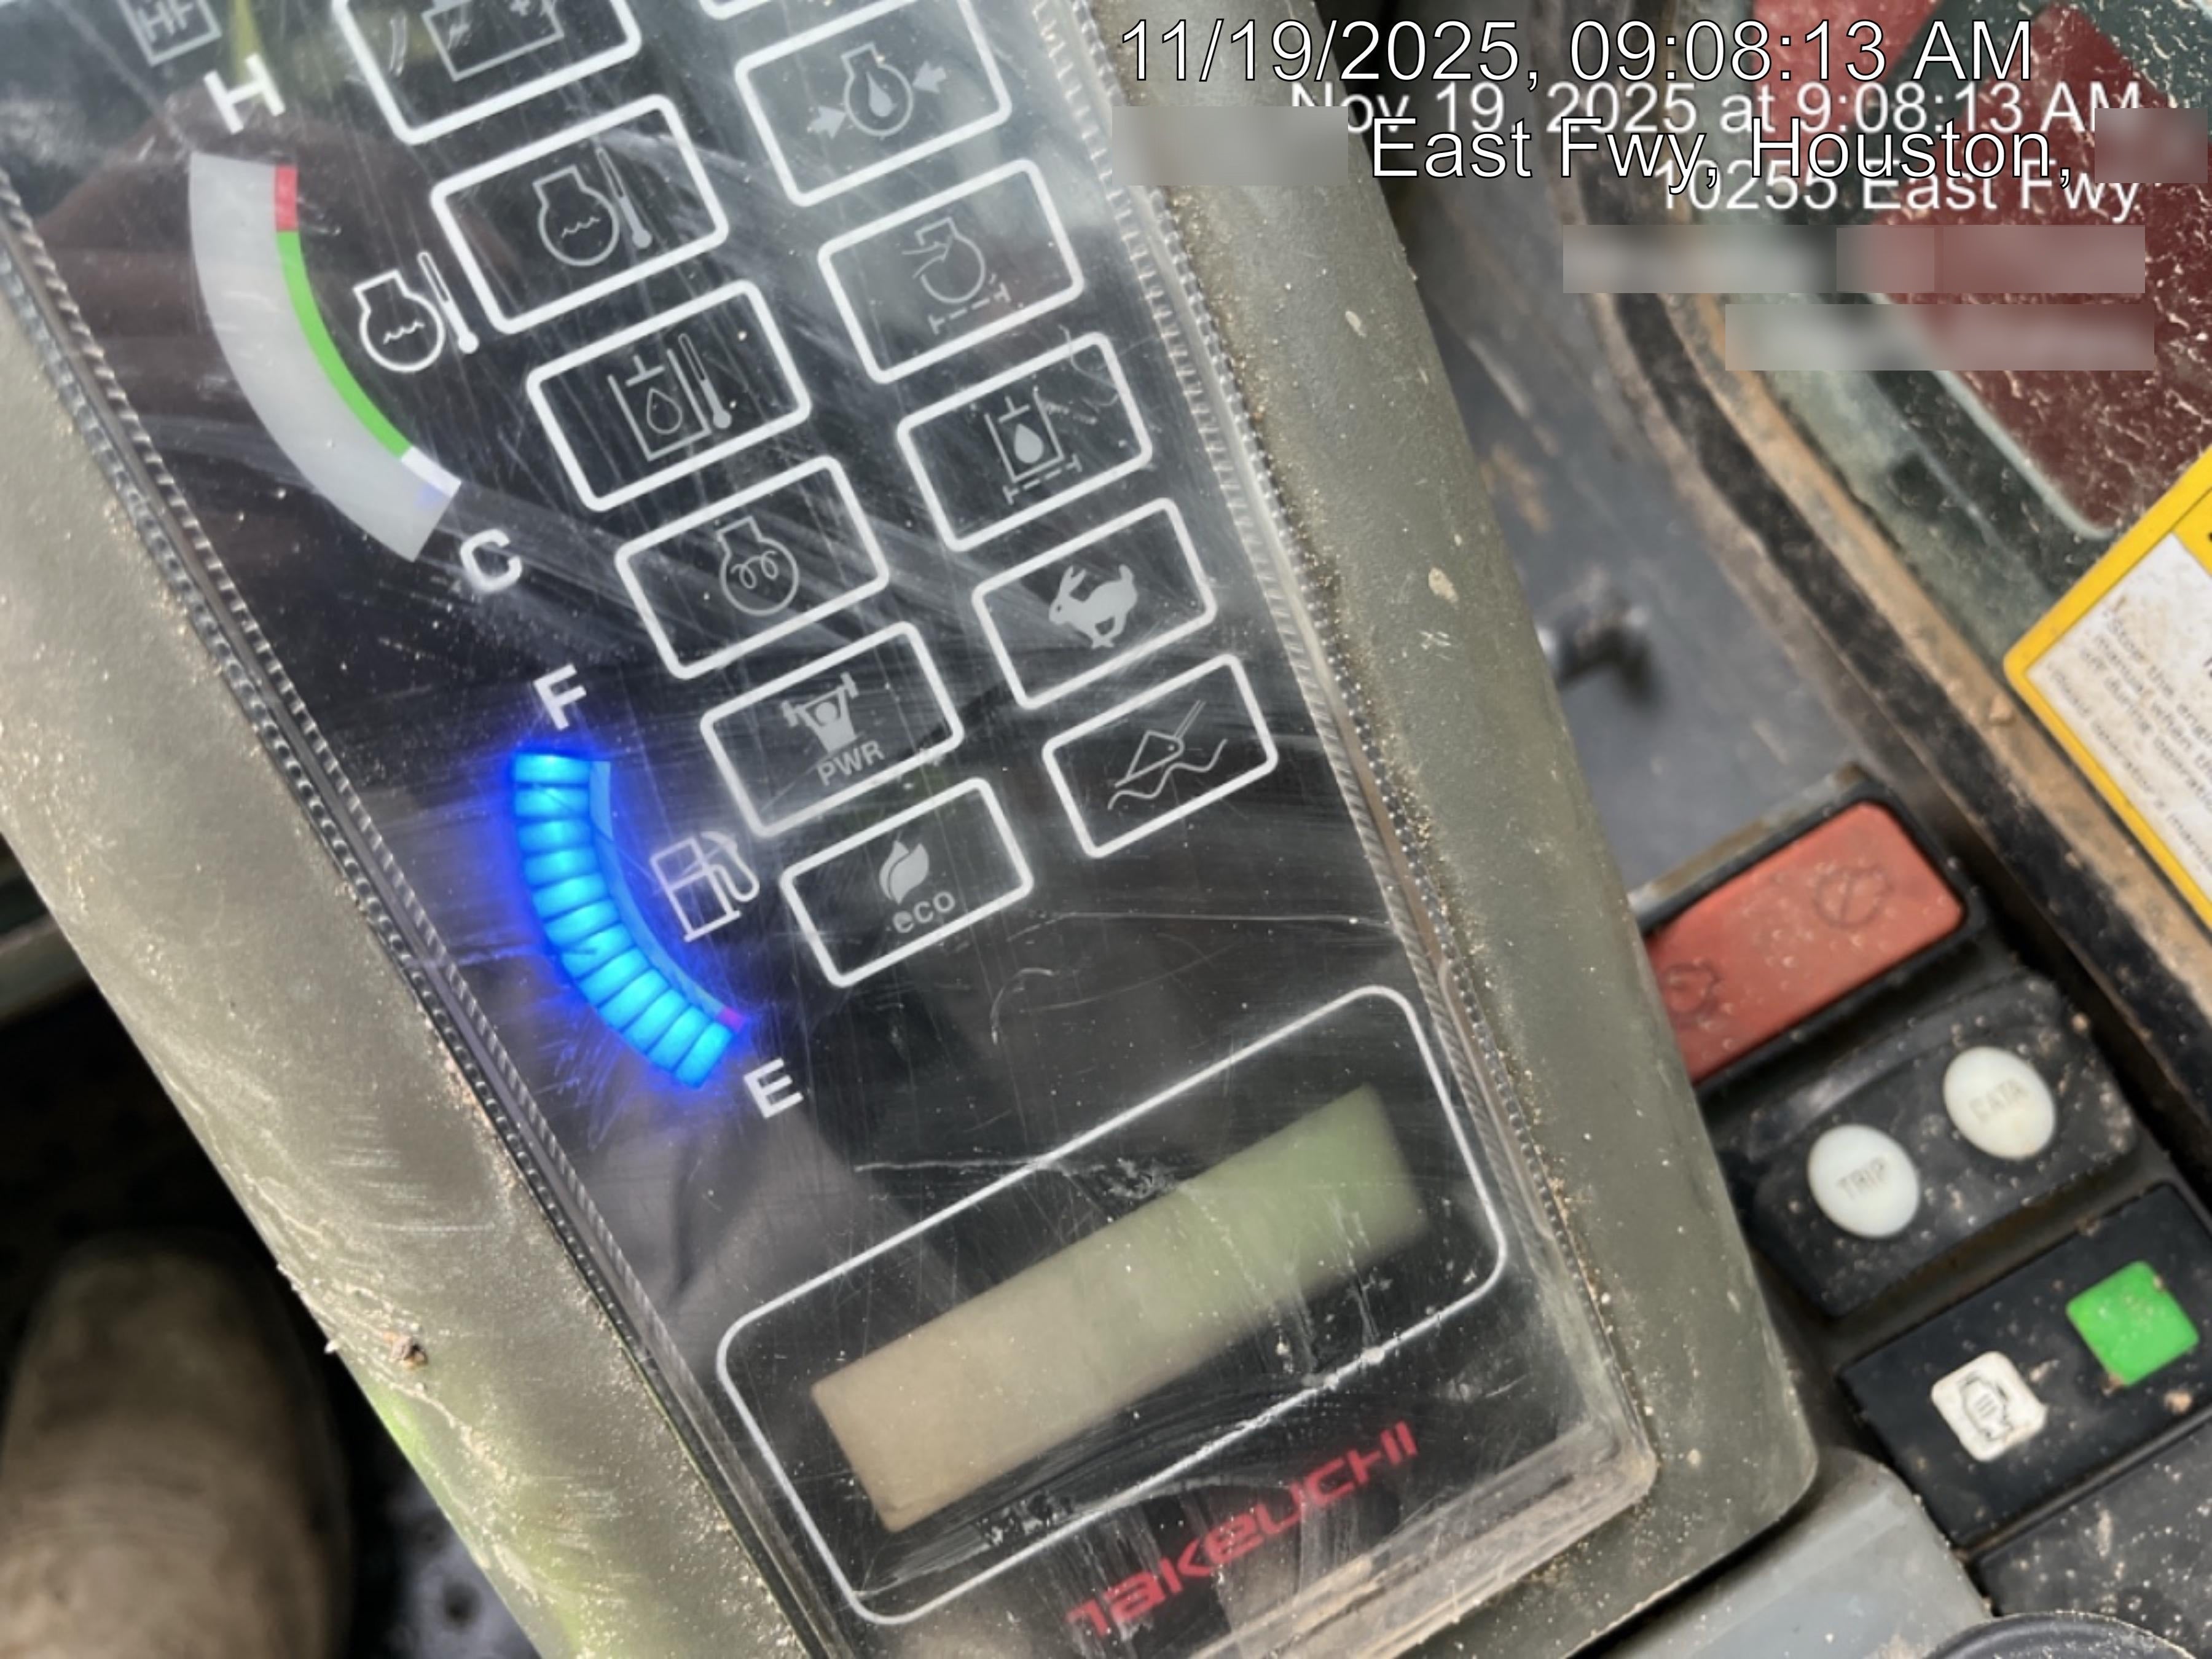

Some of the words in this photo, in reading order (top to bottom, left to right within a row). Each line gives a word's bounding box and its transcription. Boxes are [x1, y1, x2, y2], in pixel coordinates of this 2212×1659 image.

[203, 53, 285, 135] H
[460, 528, 523, 593] C
[533, 664, 587, 729] F
[817, 740, 885, 787] PWR
[743, 1058, 804, 1118] E
